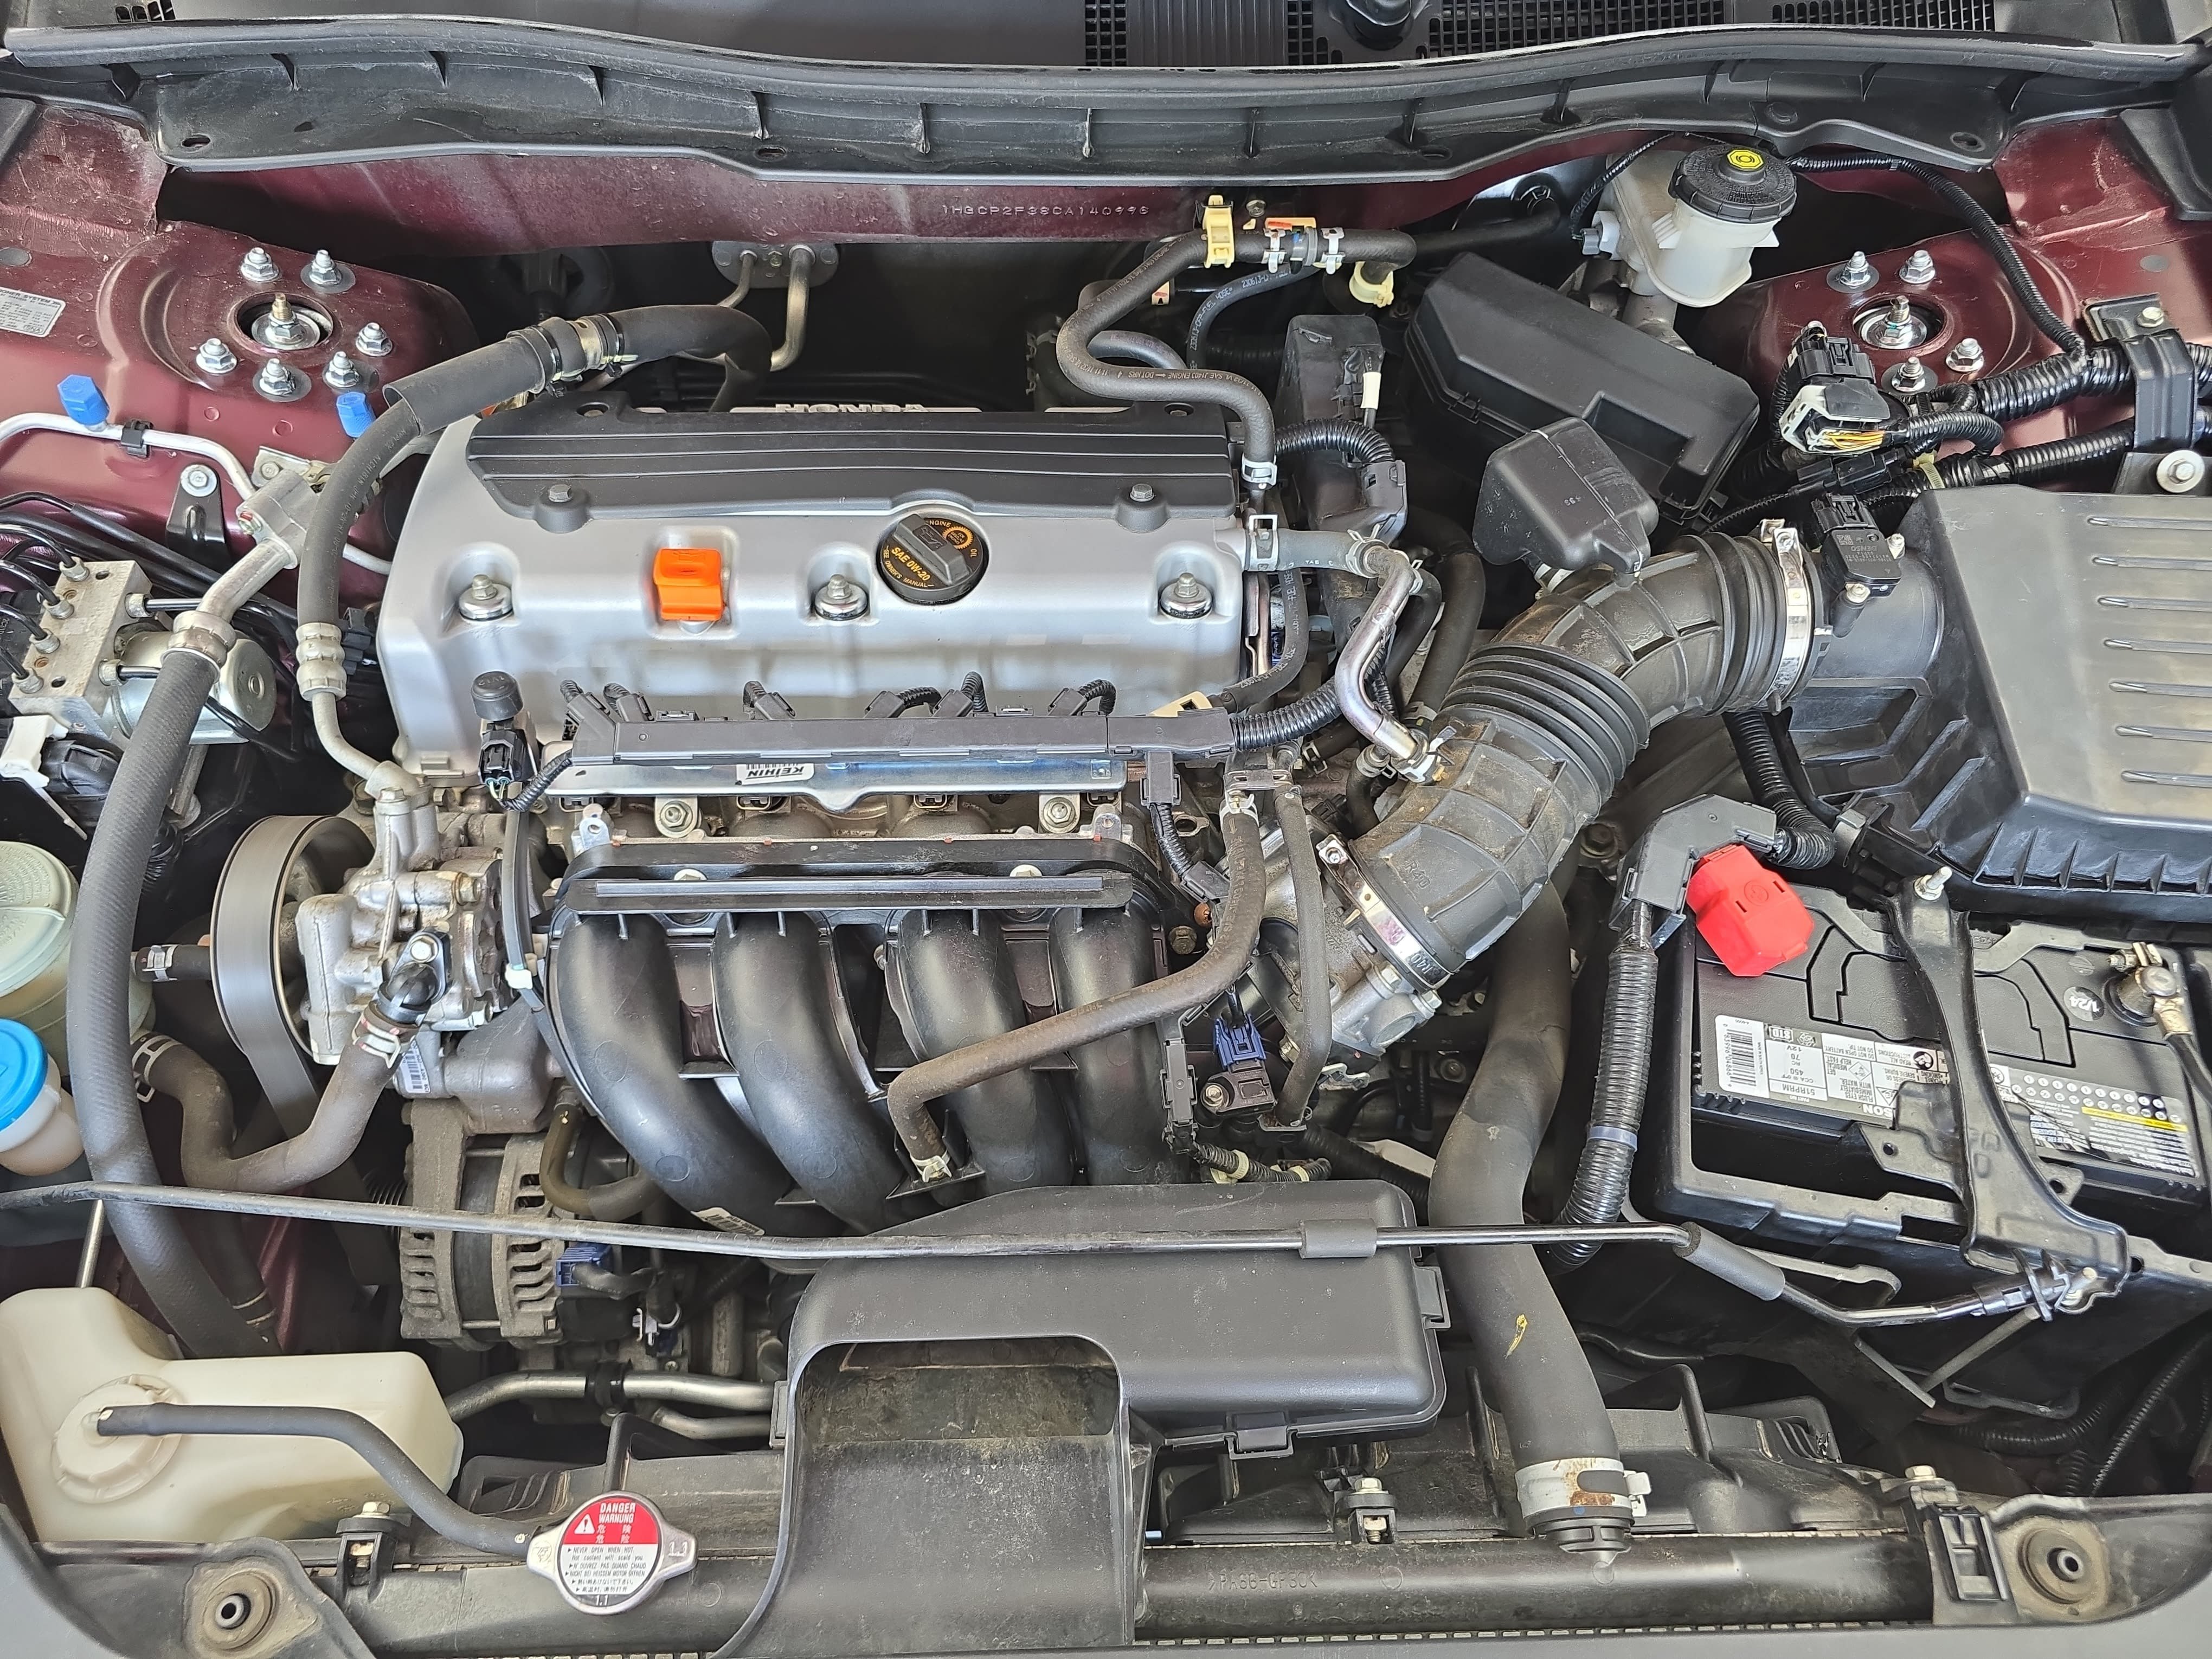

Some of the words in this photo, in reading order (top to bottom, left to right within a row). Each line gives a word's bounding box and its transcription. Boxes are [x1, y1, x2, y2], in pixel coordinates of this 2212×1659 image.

[969, 548, 978, 558] OIL
[891, 546, 911, 563] SAE
[906, 561, 931, 581] 0W-20
[748, 766, 804, 777] KEIHIN
[1772, 1027, 1791, 1039] STD
[1826, 1063, 1848, 1071] MEDICAL
[1782, 1084, 1816, 1096] 51RPRM
[1863, 1104, 1895, 1118] SON
[600, 1502, 636, 1513] DANGER
[599, 1513, 634, 1523] WARNUNG
[596, 1594, 608, 1606] 1.1
